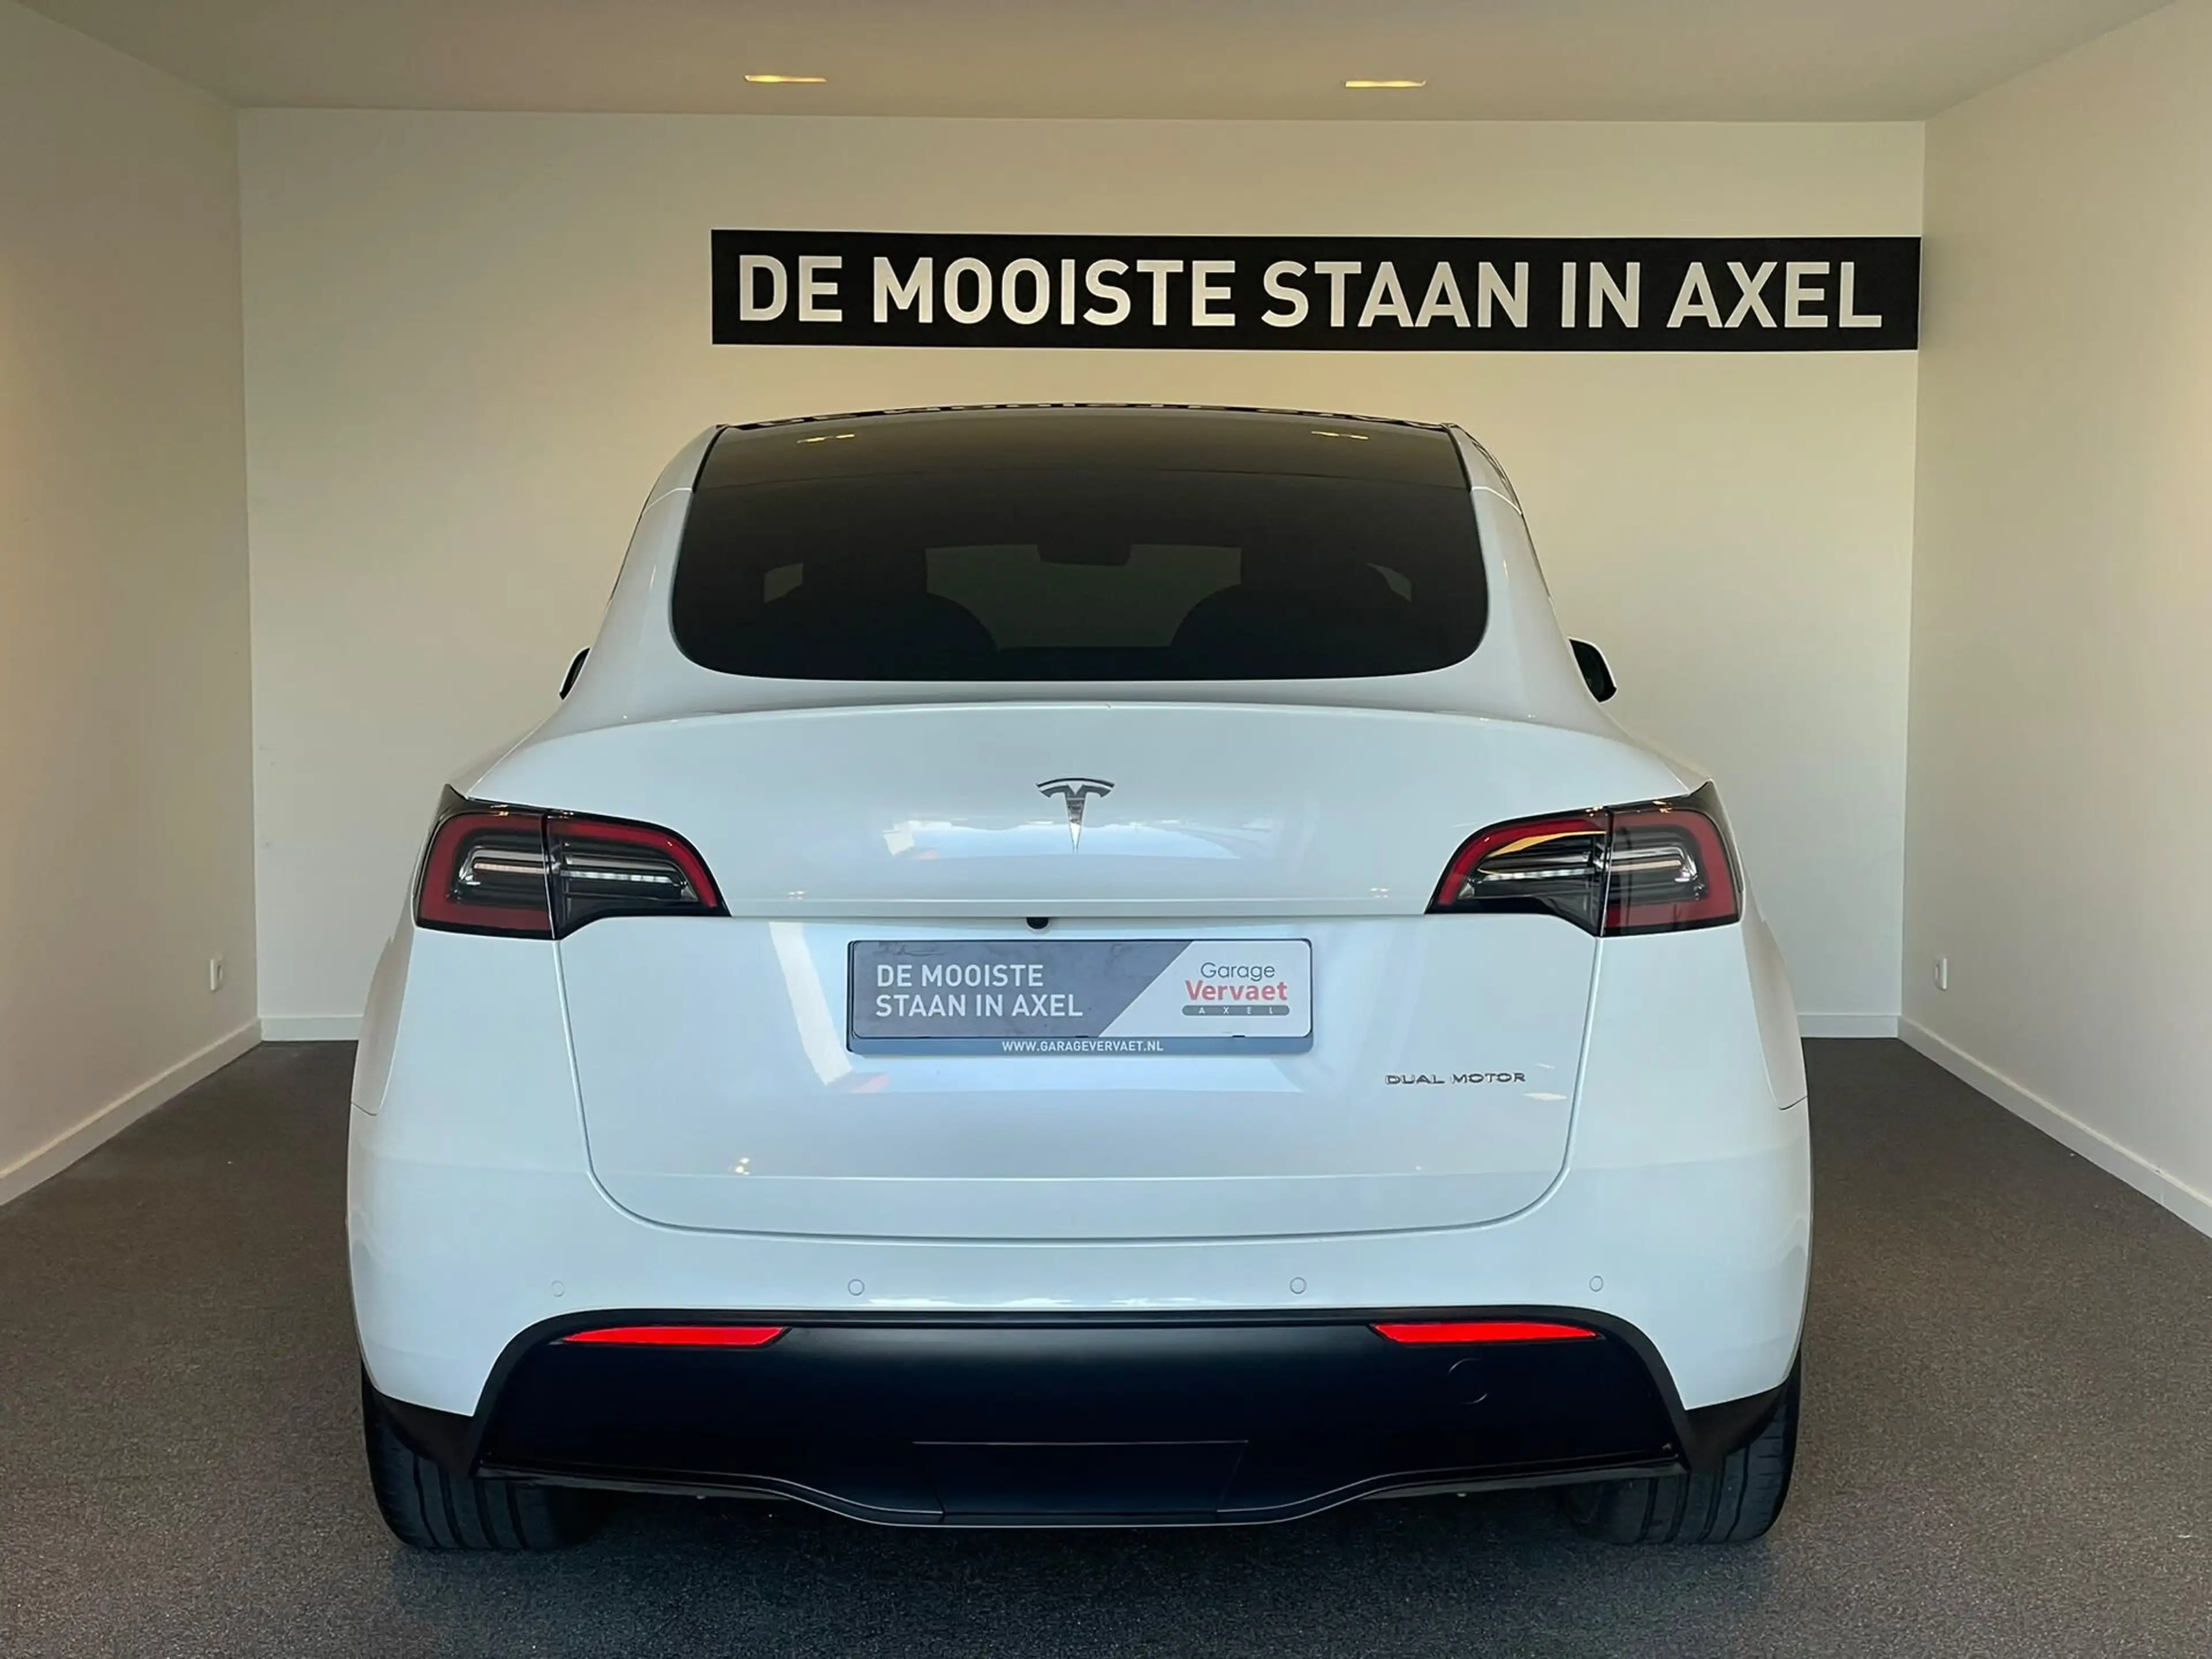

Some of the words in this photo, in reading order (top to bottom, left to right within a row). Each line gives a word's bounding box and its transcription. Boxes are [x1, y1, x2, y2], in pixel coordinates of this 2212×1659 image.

[739, 255, 843, 323] DE
[873, 256, 1236, 327] MOOISTE
[1261, 260, 1529, 328] STAAN
[1561, 261, 1641, 328] IN
[1666, 261, 1883, 328] AXEL
[877, 964, 912, 987] DE
[922, 964, 1044, 987] MOOISTE
[1200, 961, 1276, 980] Garage
[1184, 980, 1289, 1001] Vervaet
[876, 994, 967, 1017] STAAN
[976, 994, 1003, 1017] IN
[1011, 994, 1084, 1017] AXEL
[1001, 1040, 1164, 1052] WWW.GARAGEVERVAET.NL
[1385, 1074, 1445, 1085] DUAL
[1452, 1072, 1527, 1084] MOTOR
